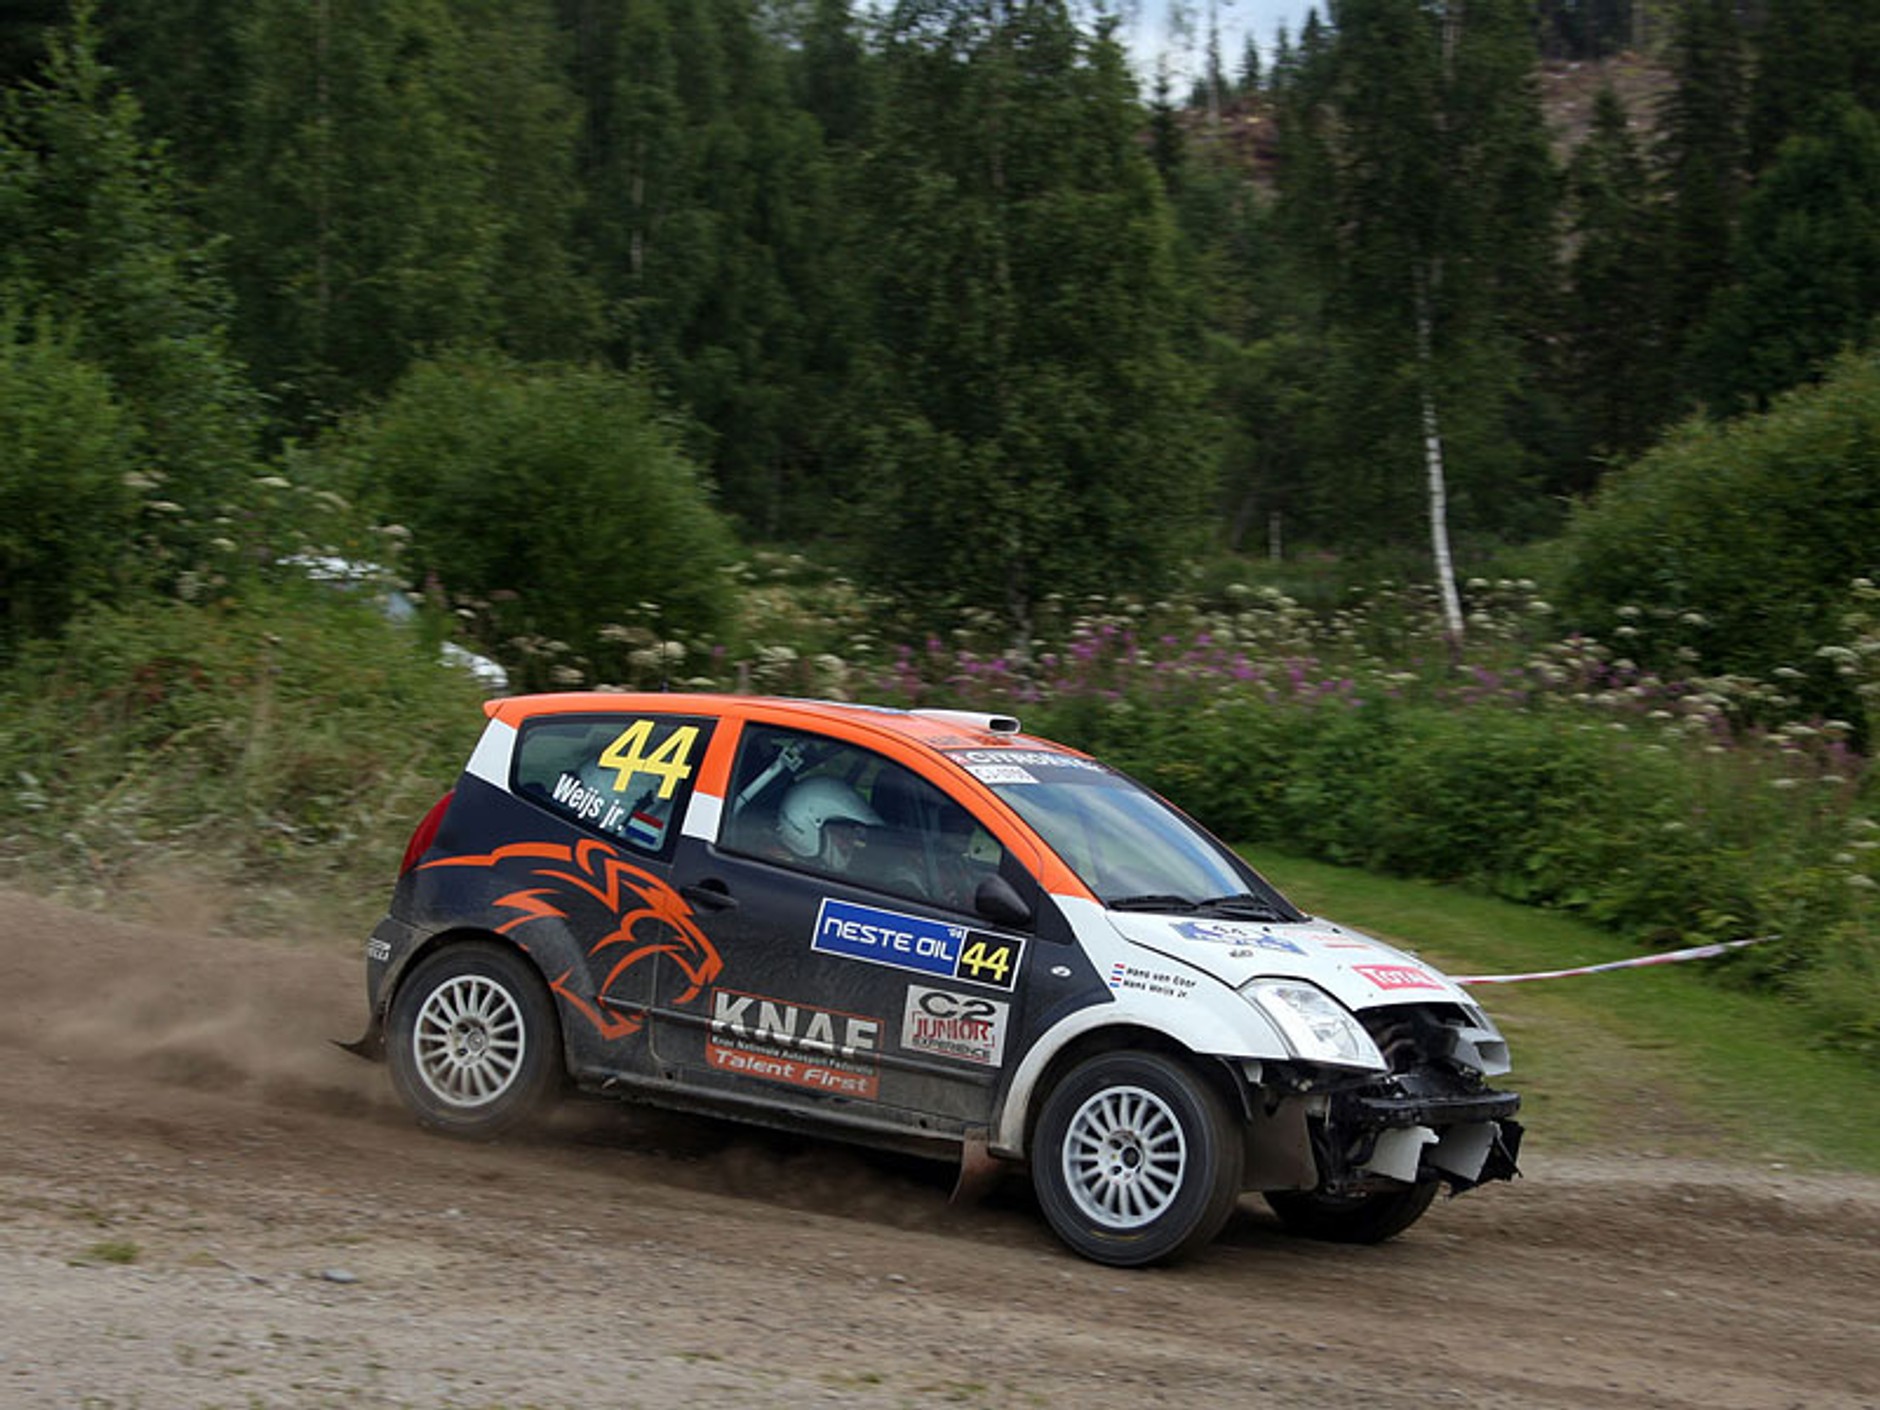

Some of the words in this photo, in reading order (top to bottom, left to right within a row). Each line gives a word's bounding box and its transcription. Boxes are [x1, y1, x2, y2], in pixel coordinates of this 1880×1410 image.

[598, 719, 699, 799] 44
[553, 773, 604, 818] Weijs
[599, 799, 624, 831] jr.
[823, 917, 912, 952] NESTE
[916, 937, 953, 960] OIL
[962, 942, 1010, 981] 44
[712, 991, 878, 1054] KNAF
[913, 1018, 989, 1041] JUNIOR
[919, 992, 995, 1027] C2
[715, 1049, 794, 1077] Talent
[803, 1068, 870, 1092] First
